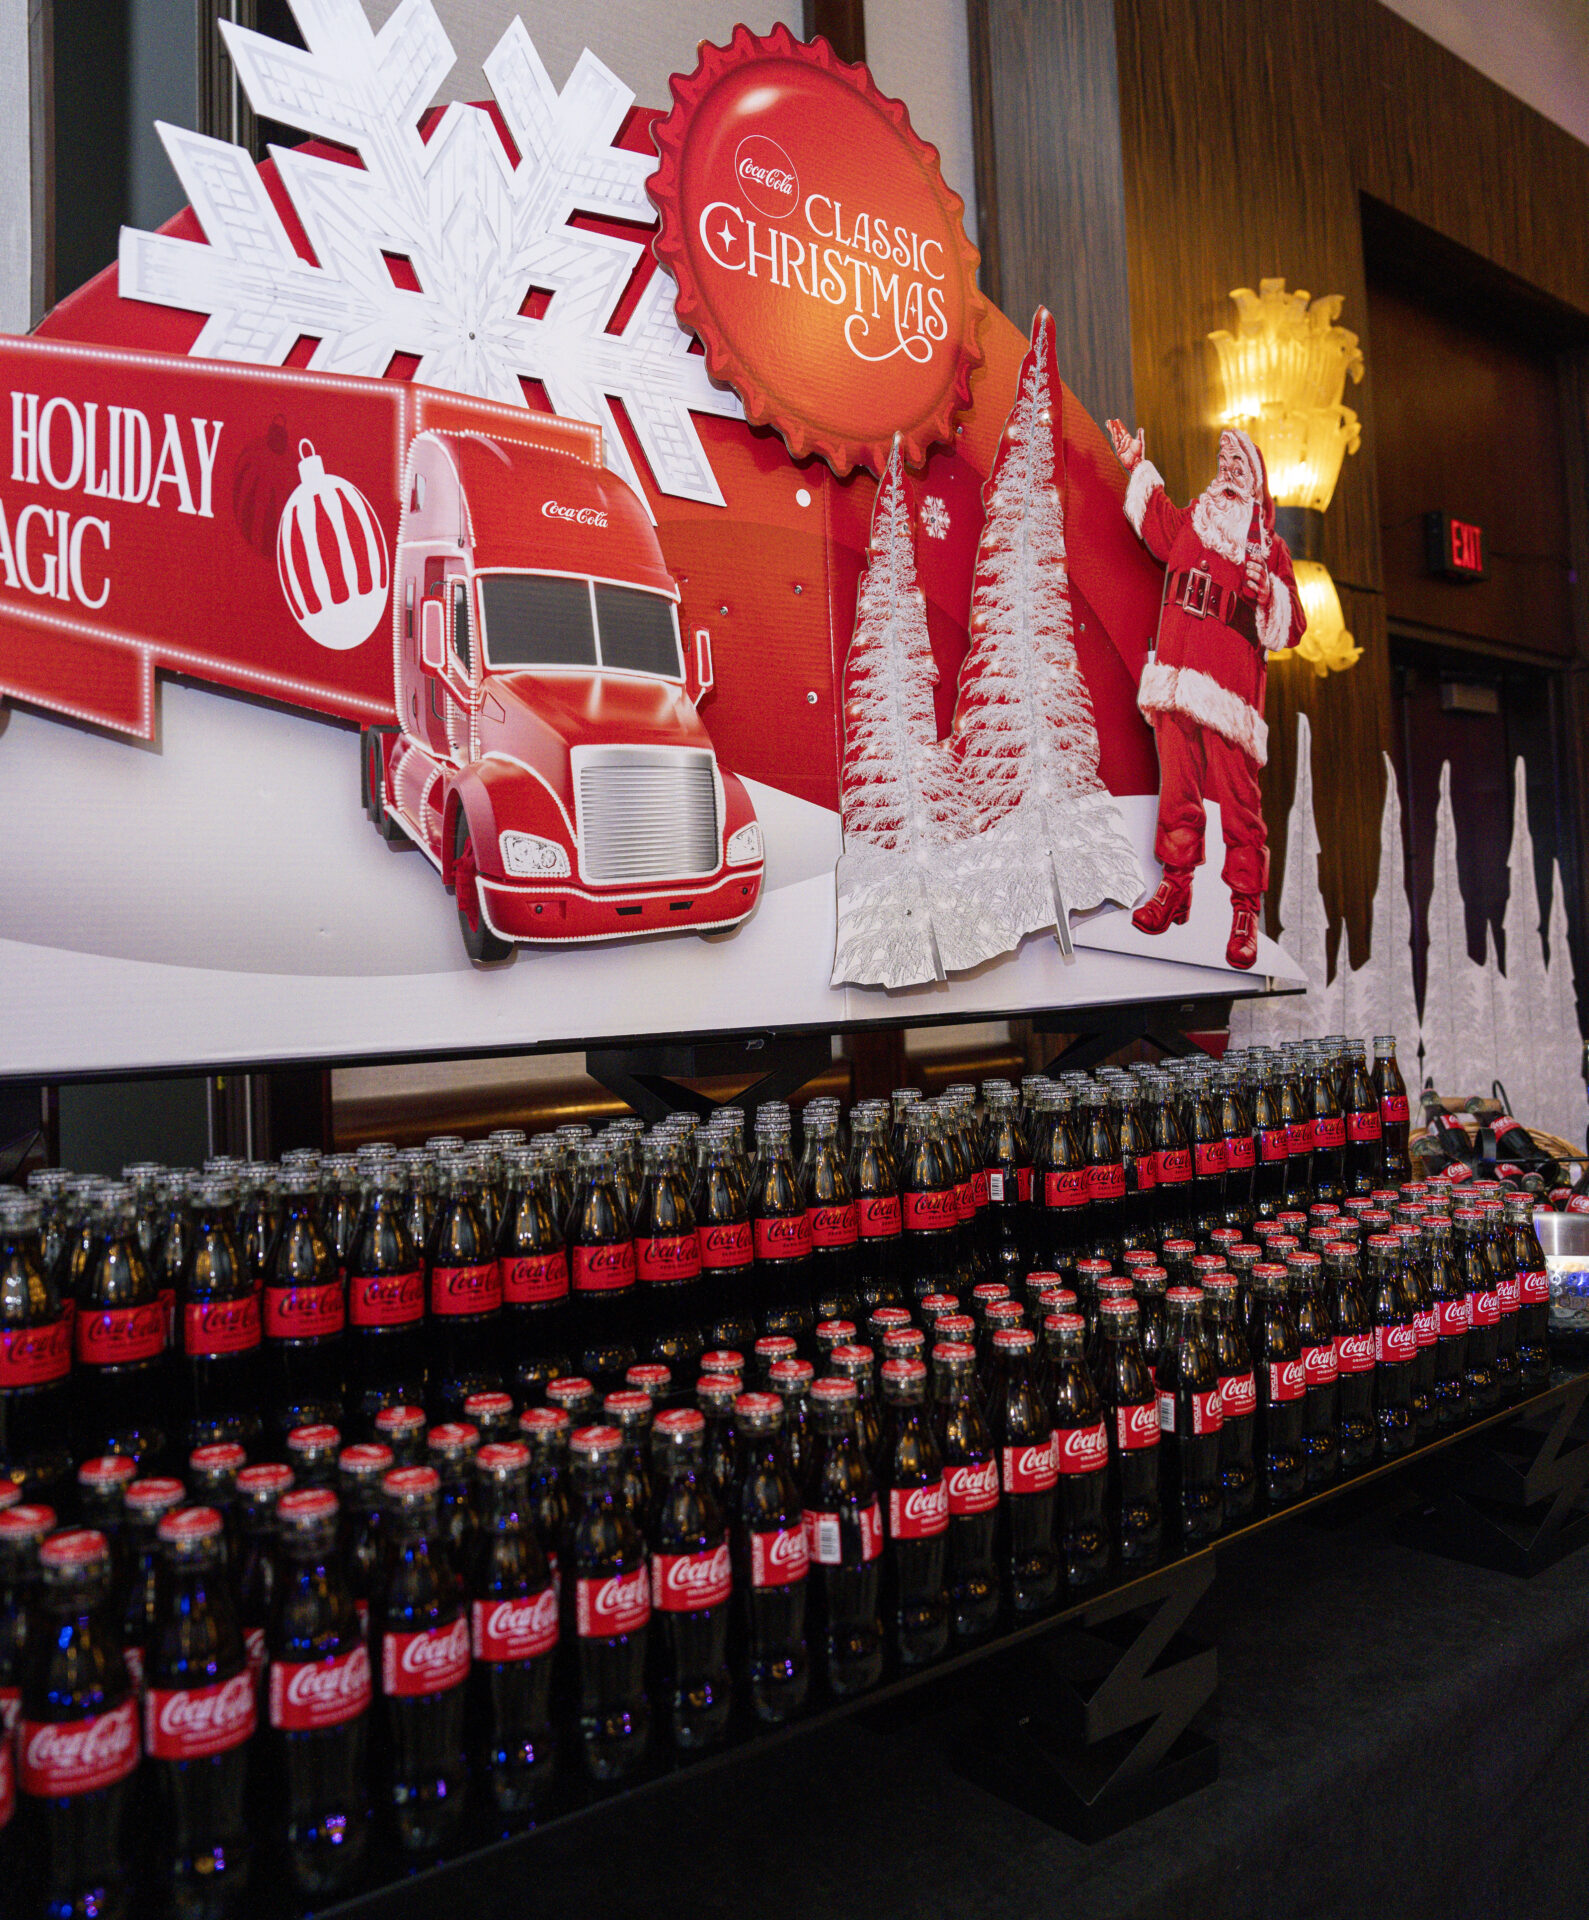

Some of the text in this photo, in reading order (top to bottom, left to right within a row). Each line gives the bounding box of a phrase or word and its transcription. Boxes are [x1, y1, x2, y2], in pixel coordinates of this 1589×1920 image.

[738, 157, 796, 195] Coca-Cola
[804, 193, 946, 281] CLASSIC
[699, 201, 949, 364] CHRISTMAS
[10, 390, 225, 519] HOLIDAY
[541, 499, 609, 528] Coca-Cola
[1450, 519, 1483, 572] EXIT
